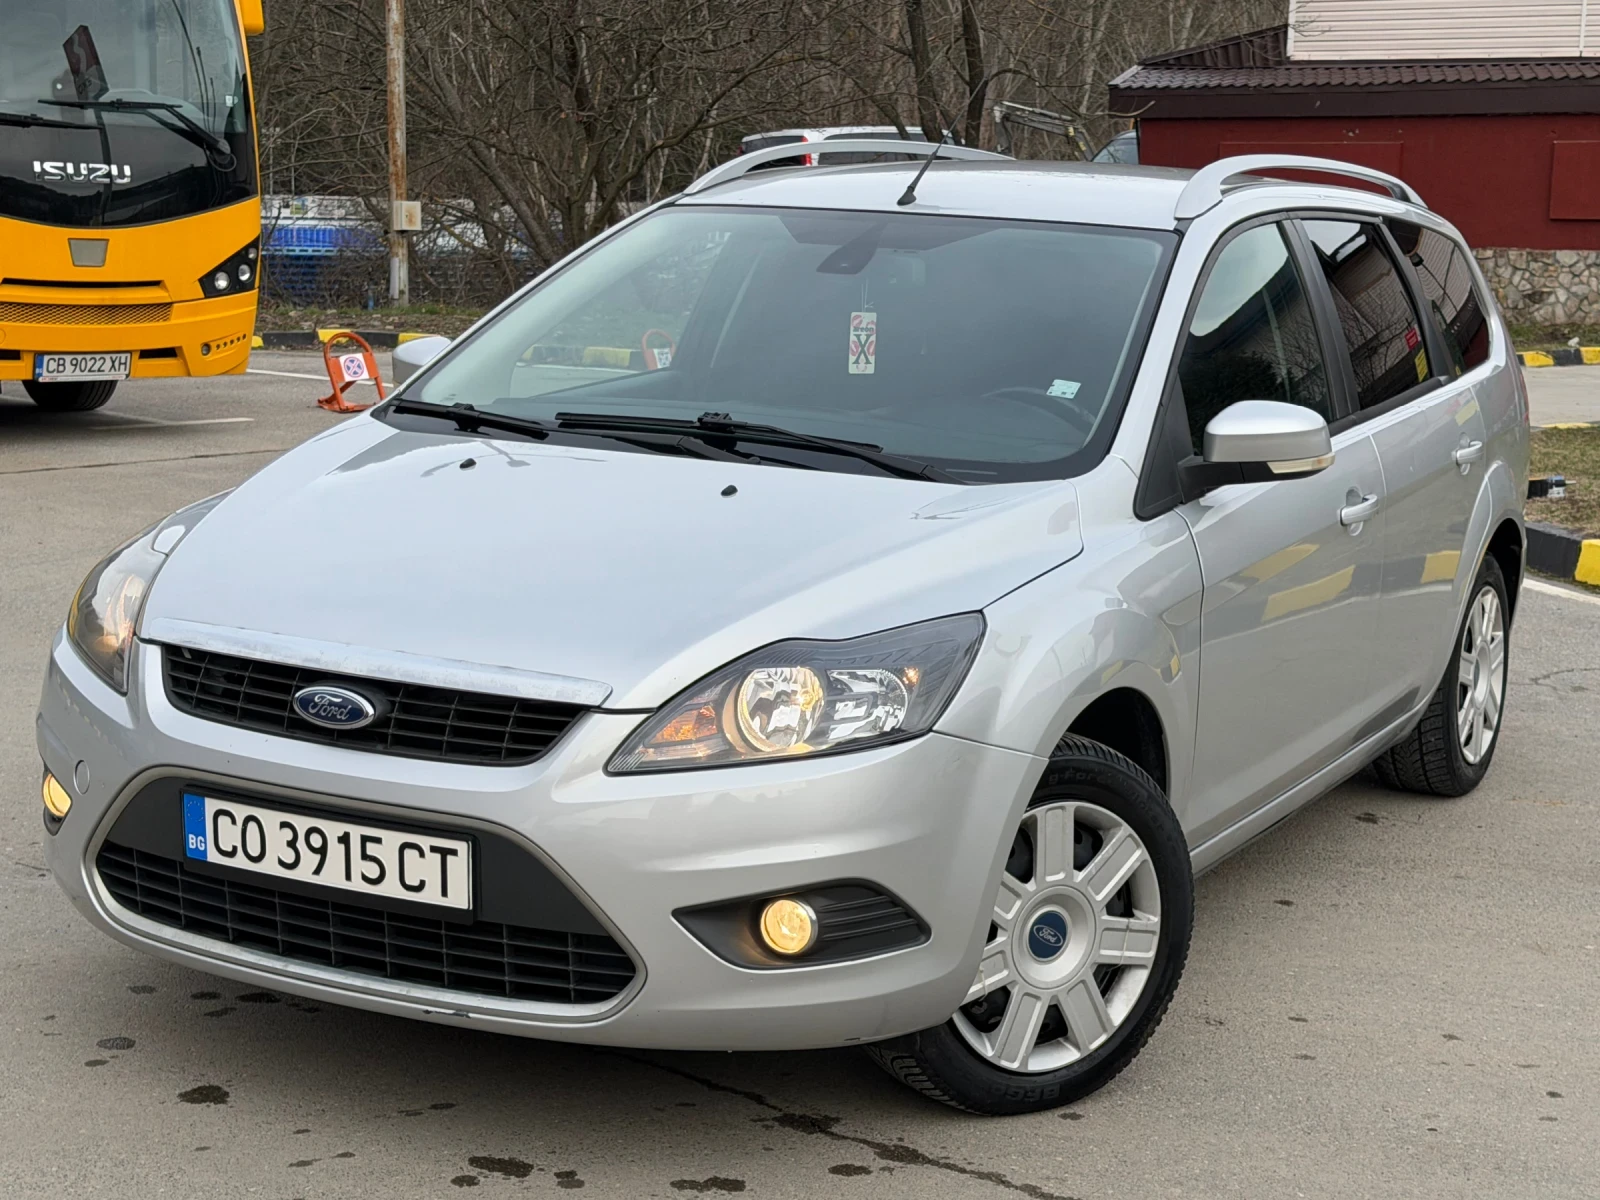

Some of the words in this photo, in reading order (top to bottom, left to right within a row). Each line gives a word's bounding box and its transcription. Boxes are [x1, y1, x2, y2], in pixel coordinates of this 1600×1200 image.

[33, 161, 131, 183] ISUZU
[46, 357, 66, 374] CB
[70, 357, 106, 374] 9022
[108, 355, 128, 373] XH
[308, 693, 352, 720] Ford
[188, 833, 206, 851] BG
[212, 808, 267, 864] CO
[277, 820, 387, 886] 3915
[398, 841, 460, 899] CT
[1039, 927, 1058, 943] Ford
